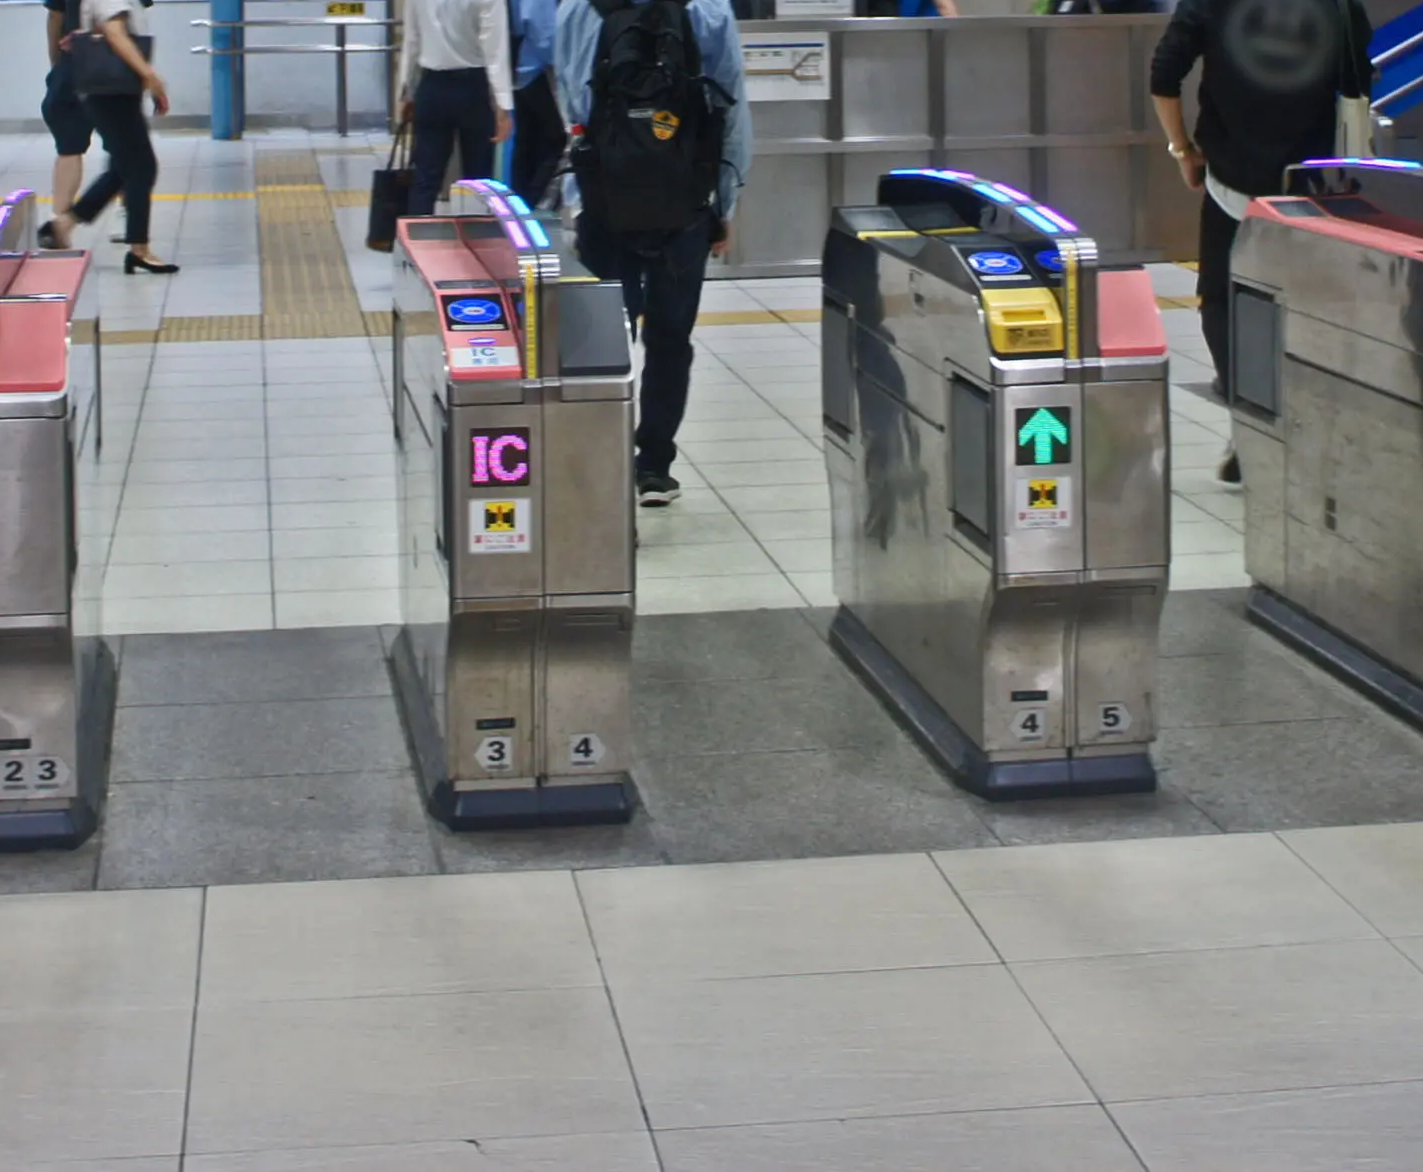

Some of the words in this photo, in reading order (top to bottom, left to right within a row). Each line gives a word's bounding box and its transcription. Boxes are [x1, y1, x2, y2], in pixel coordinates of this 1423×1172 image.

[471, 434, 528, 484] IC
[1020, 712, 1039, 733] 4
[1101, 706, 1121, 727] 5
[487, 740, 506, 762] 3
[573, 737, 594, 758] 4
[3, 760, 24, 784] 2
[37, 759, 58, 782] 3
